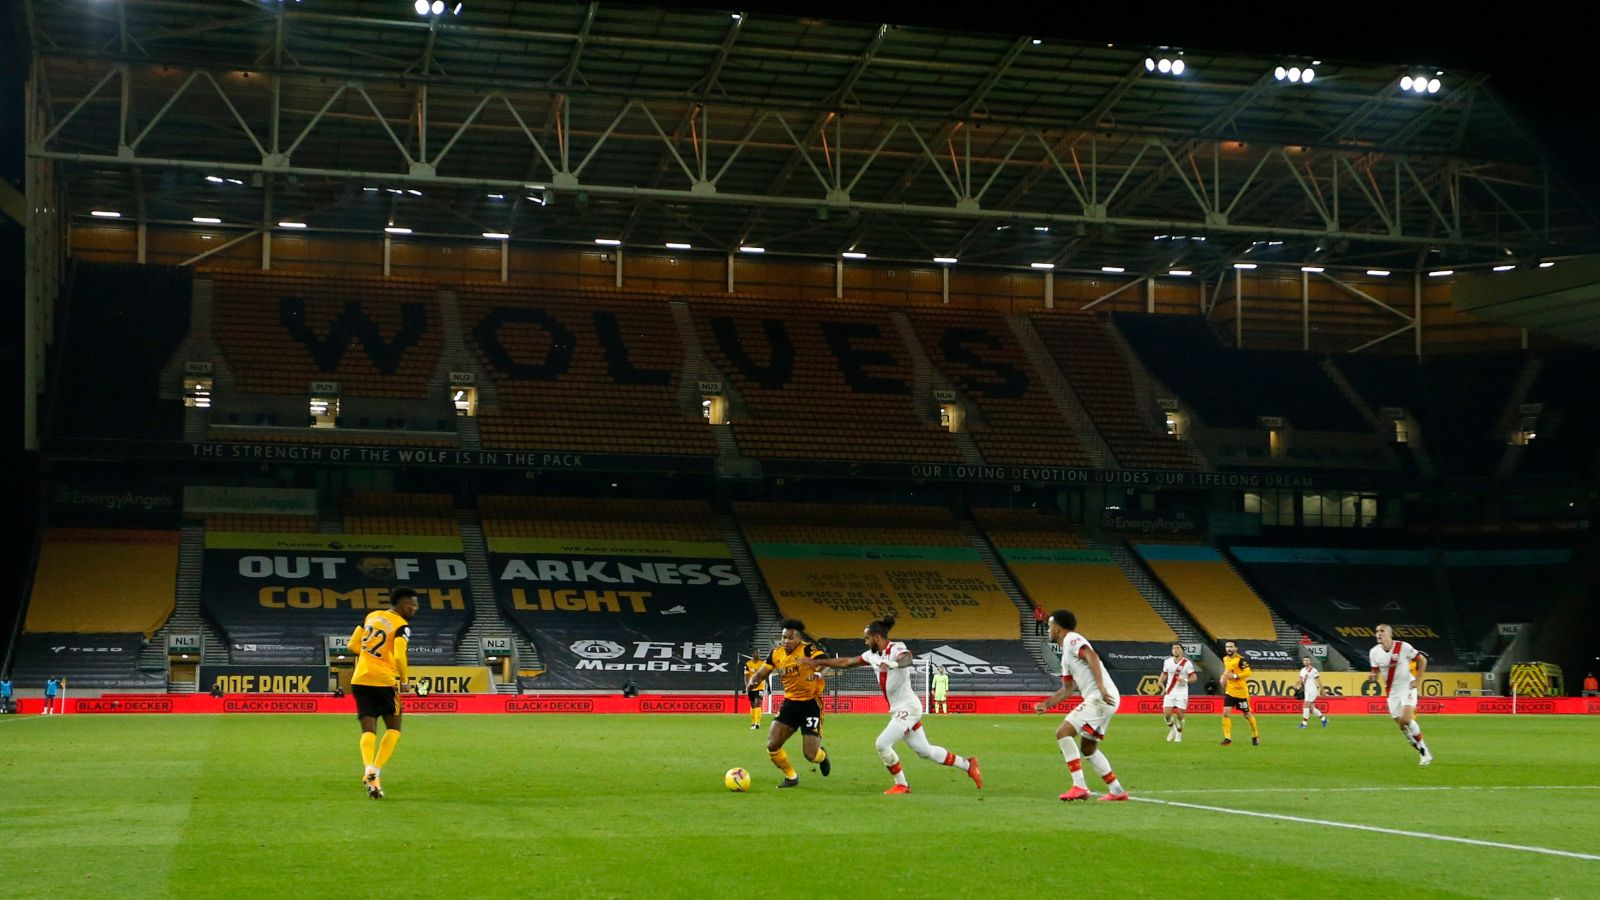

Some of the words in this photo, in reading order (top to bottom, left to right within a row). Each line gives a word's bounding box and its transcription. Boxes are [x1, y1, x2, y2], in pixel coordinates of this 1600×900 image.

[278, 295, 1029, 398] WOLVES
[453, 373, 470, 381] NU2
[701, 383, 718, 391] NU3
[191, 444, 225, 456] THE
[231, 445, 322, 460] STRENGTH
[329, 448, 351, 461] OF
[359, 449, 392, 462] THE
[398, 450, 439, 463] WOLF
[455, 452, 471, 464] IS
[479, 452, 497, 464] IN
[505, 453, 536, 465] THE
[543, 454, 585, 467] PACK
[911, 465, 943, 477] OUR
[948, 466, 1006, 479] LOVING
[1011, 467, 1089, 481] DEVOTION
[1095, 471, 1150, 484] GUIDES
[1155, 472, 1185, 484] OUR
[1190, 472, 1260, 486] LIFELONG
[1264, 474, 1313, 487] DREAM
[238, 555, 346, 579] OUT
[435, 558, 468, 580] D
[499, 558, 742, 586] ARKNESS
[511, 588, 653, 613] LIGHT
[175, 636, 195, 646] NL1
[335, 638, 350, 646] PL
[487, 640, 505, 648] NL2
[632, 641, 724, 660] 万博
[1308, 647, 1323, 655] NL5
[574, 659, 730, 673] ManBetX
[215, 675, 255, 694] ONE
[258, 675, 313, 694] PACK
[78, 701, 170, 711] BLACK+DECKER
[226, 701, 315, 711] BLACK+DECKER
[508, 701, 591, 711] BLACK+DECKER
[642, 701, 723, 711] BLACK+DECKER
[805, 717, 820, 728] 37
